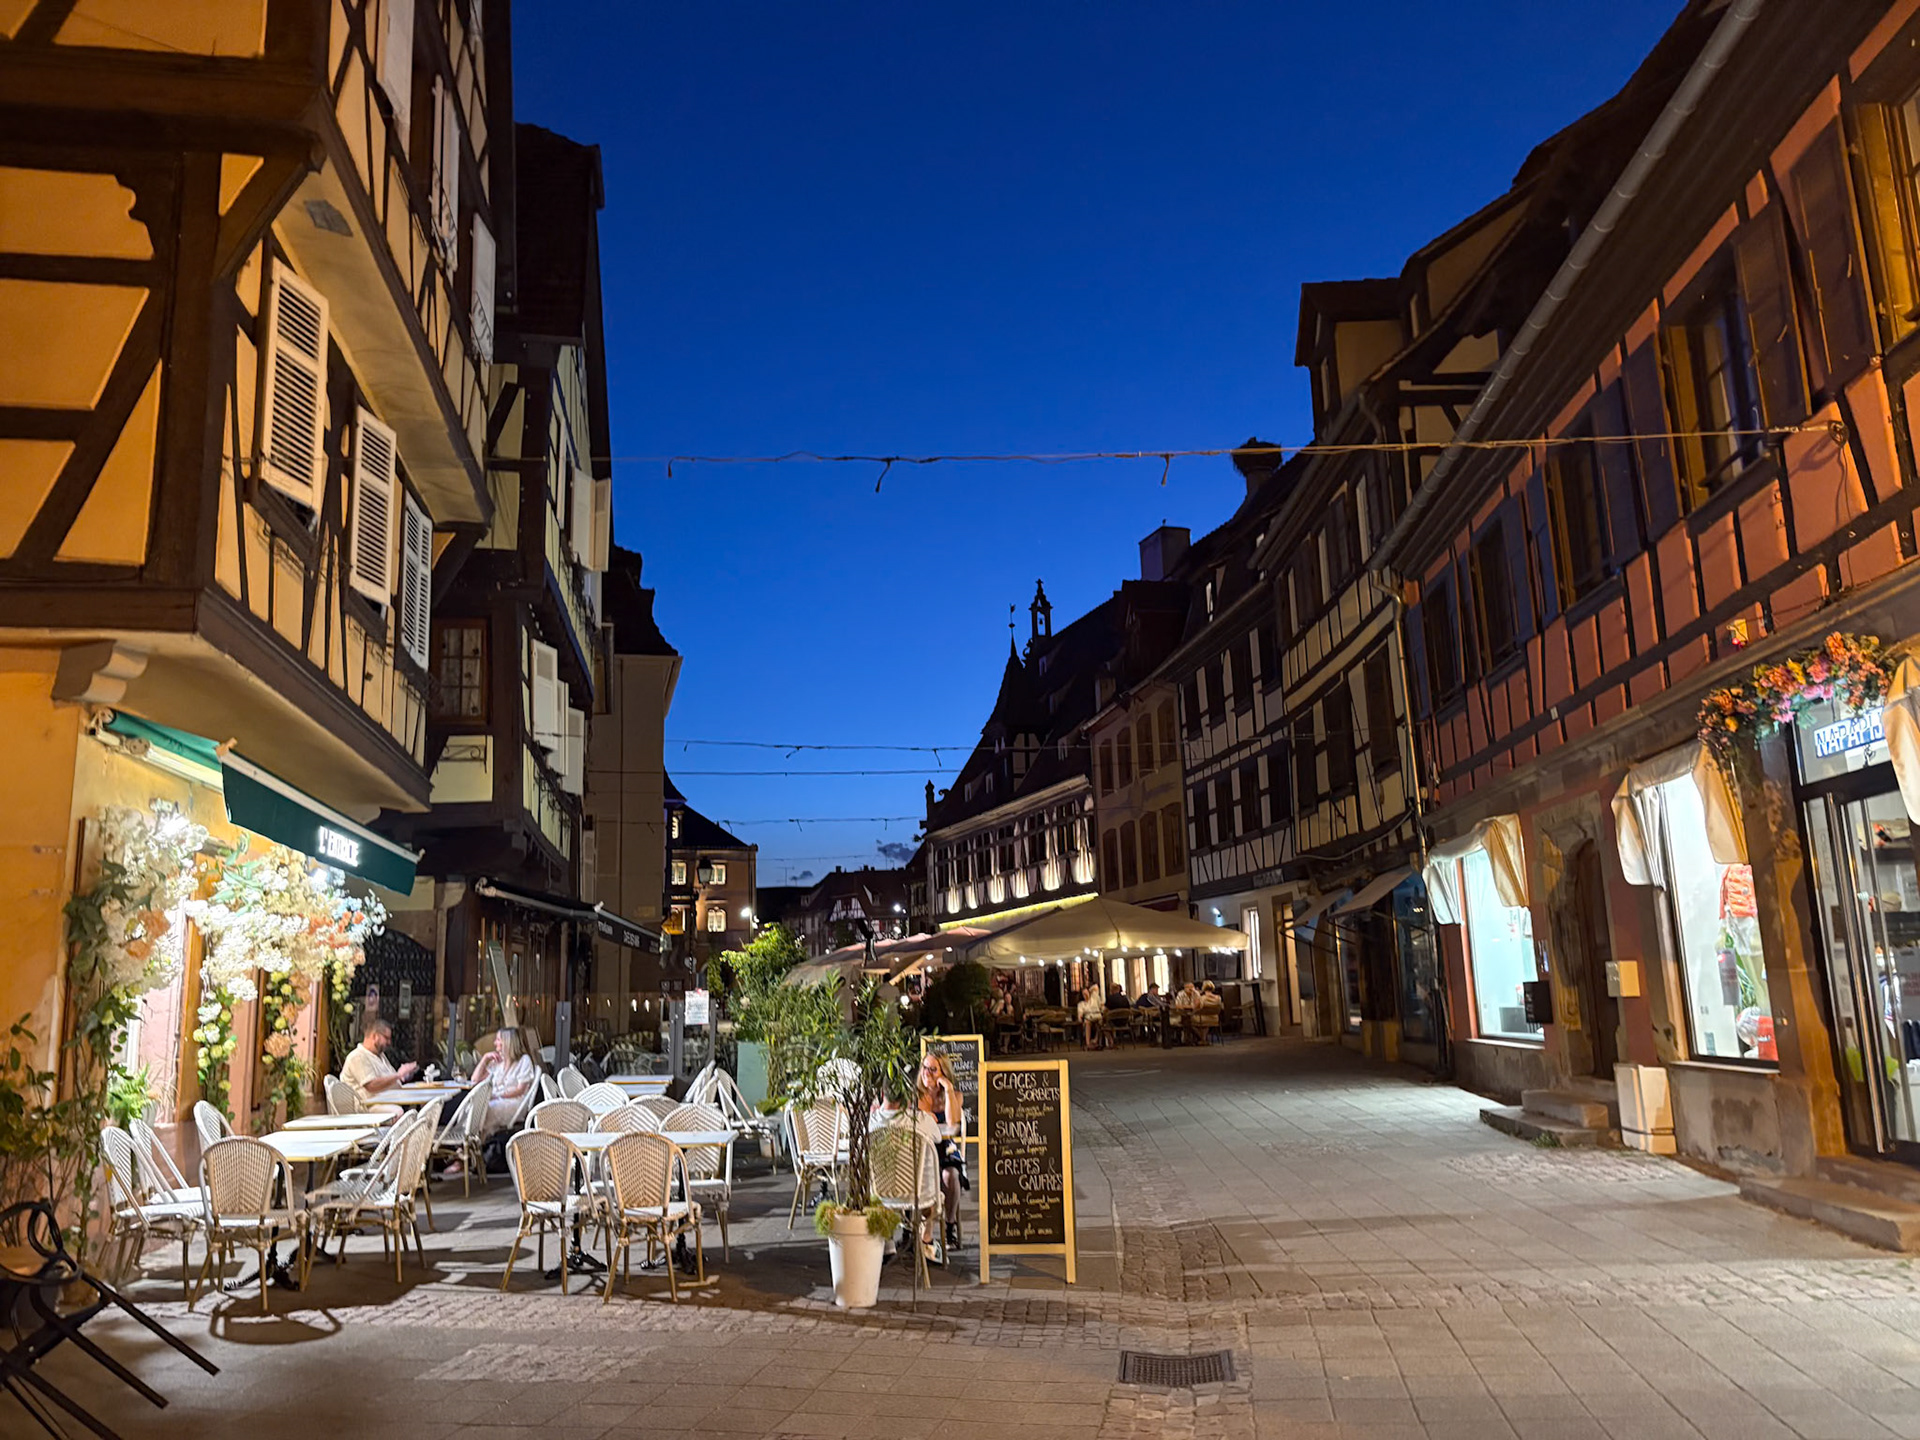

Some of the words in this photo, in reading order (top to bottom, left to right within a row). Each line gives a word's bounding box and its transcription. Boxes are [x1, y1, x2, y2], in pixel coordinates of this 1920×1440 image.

[993, 1073, 1037, 1090] GLACES
[1042, 1072, 1049, 1087] &
[1017, 1087, 1060, 1102] SORBETS
[995, 1120, 1038, 1138] SUNDAE
[1019, 1174, 1063, 1191] GAUFRES
